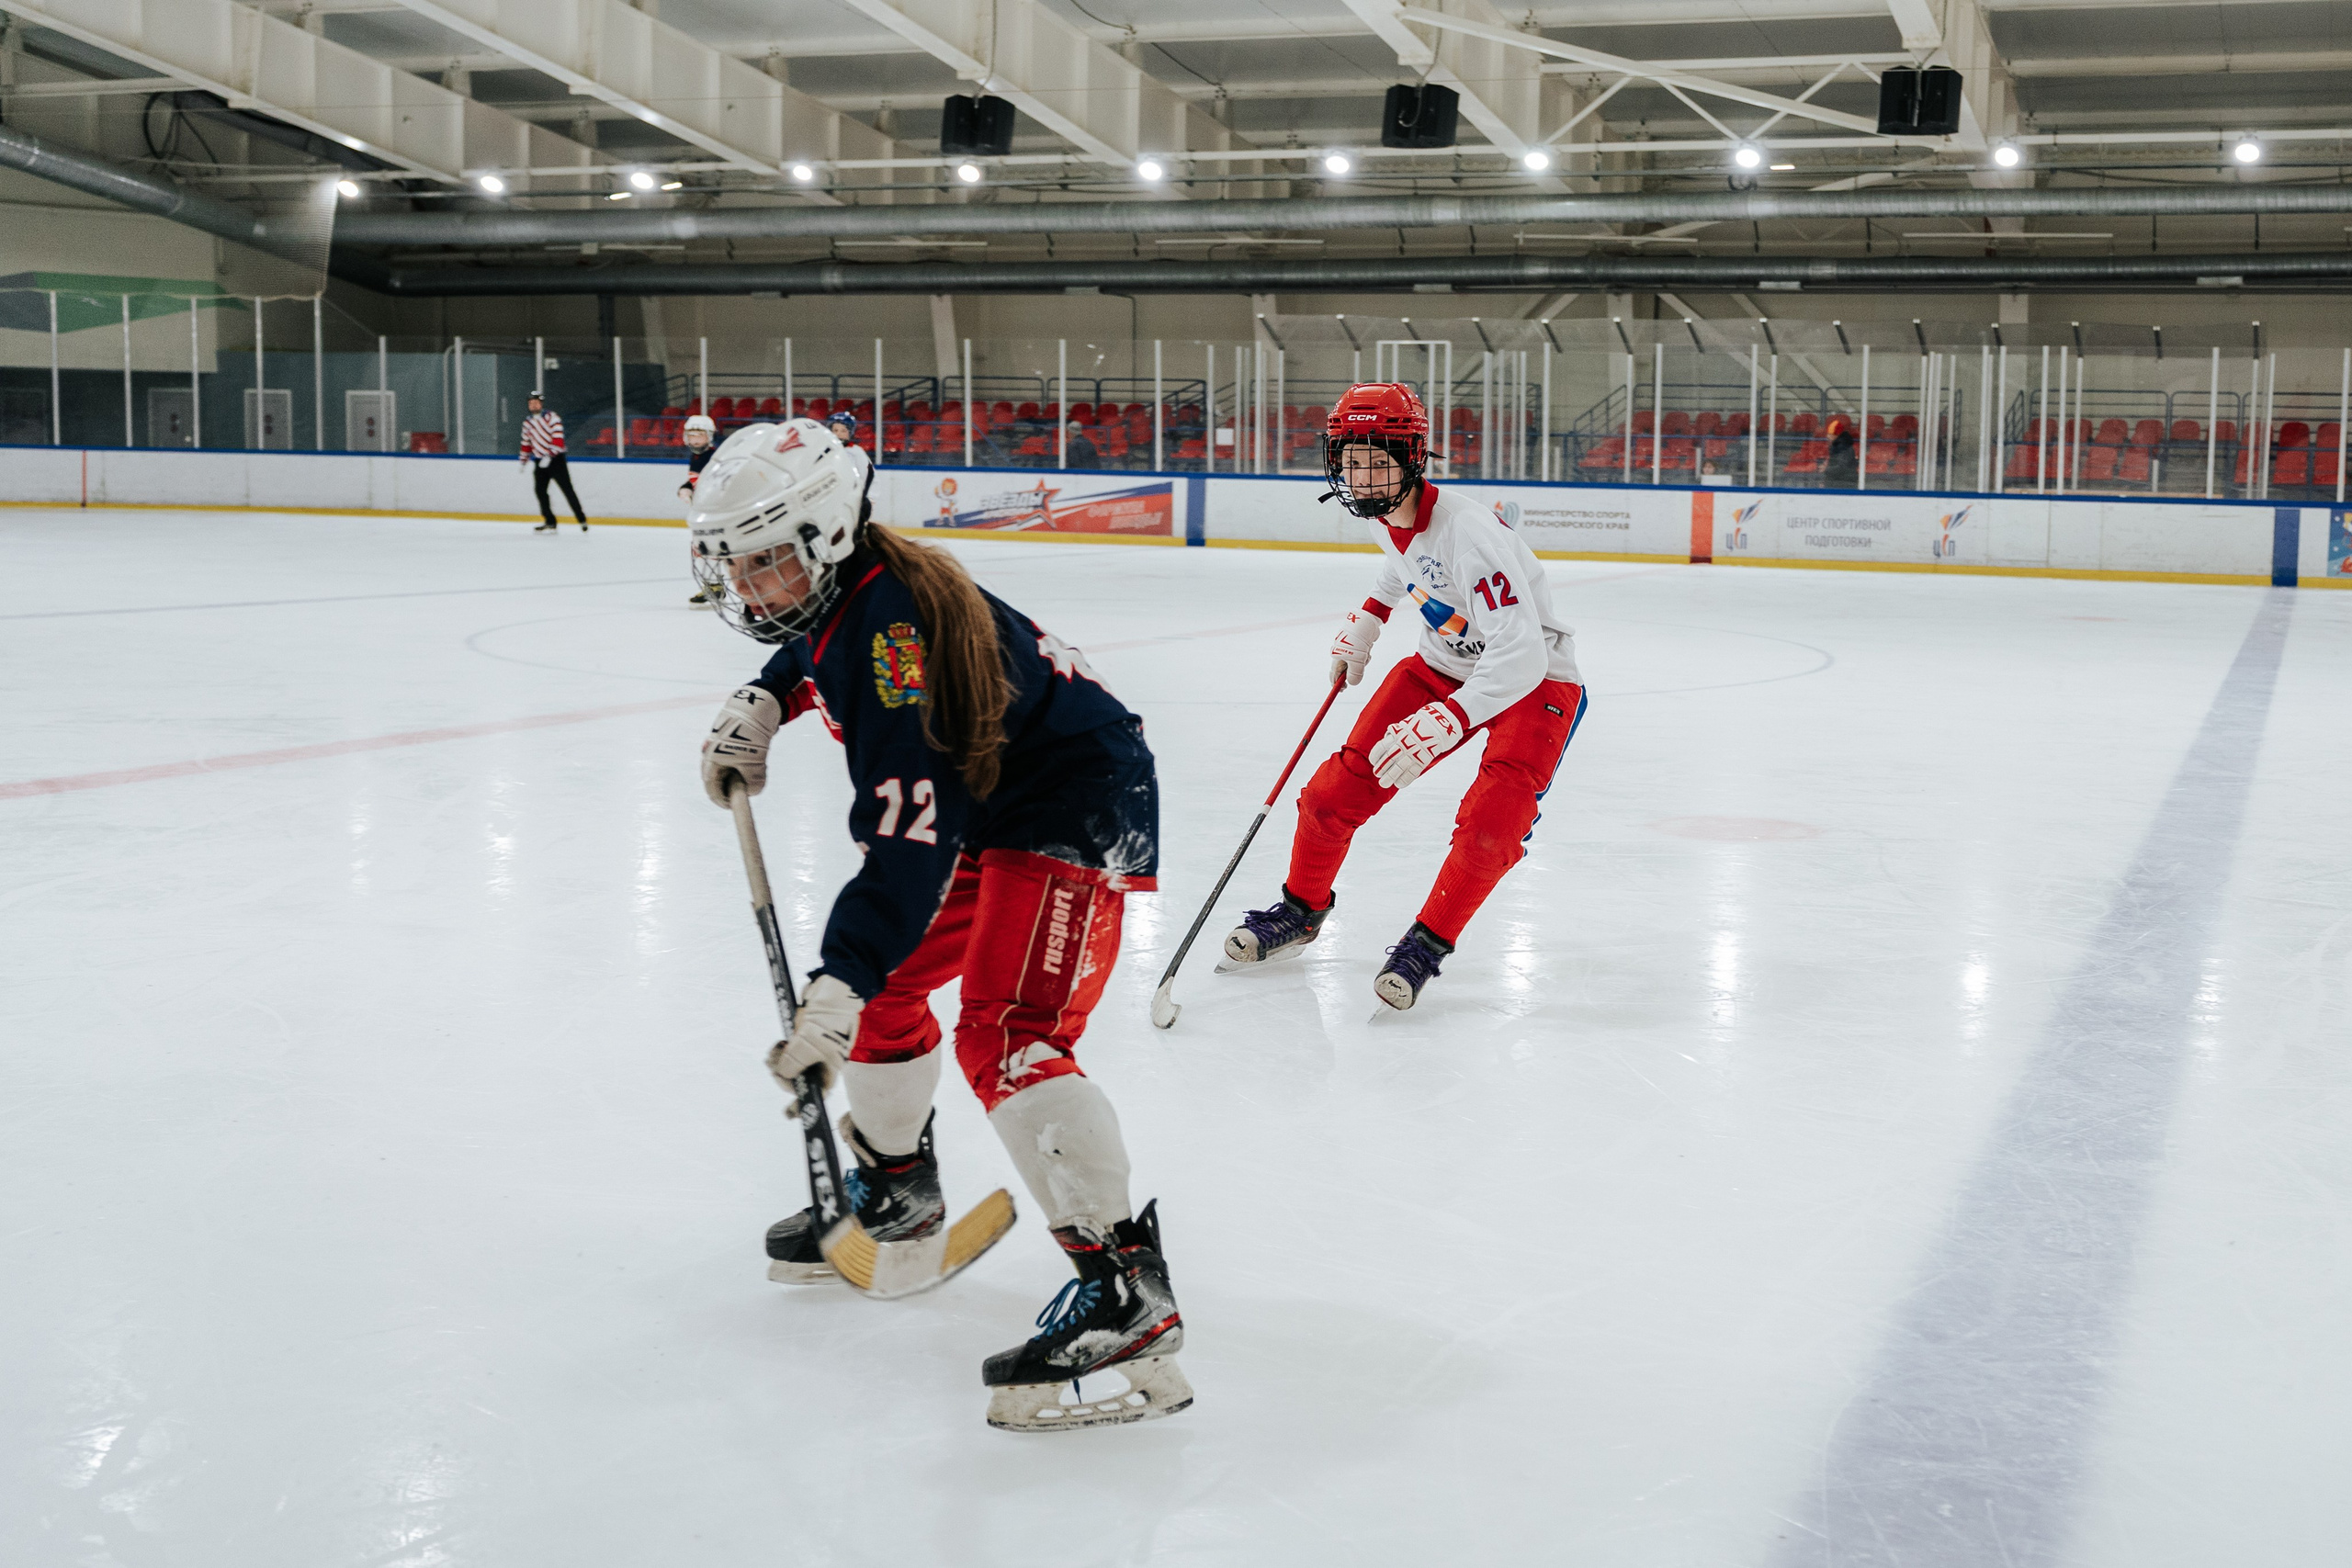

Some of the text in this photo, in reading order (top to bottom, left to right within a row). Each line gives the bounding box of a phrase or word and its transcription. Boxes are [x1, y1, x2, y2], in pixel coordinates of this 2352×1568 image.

[1523, 509, 1631, 519] МИНИСТЕРСТВО СПОРТА
[1523, 520, 1603, 529] КРАСНОЯРСКОГО
[1786, 517, 1892, 531] ЦЕНТР СПОРТИВНОЙ
[1804, 535, 1871, 548] ПОДГОТОВКИ
[1474, 570, 1519, 612] 12
[1421, 705, 1457, 737] STEX
[875, 777, 937, 846] 12
[1043, 888, 1074, 976] rusport
